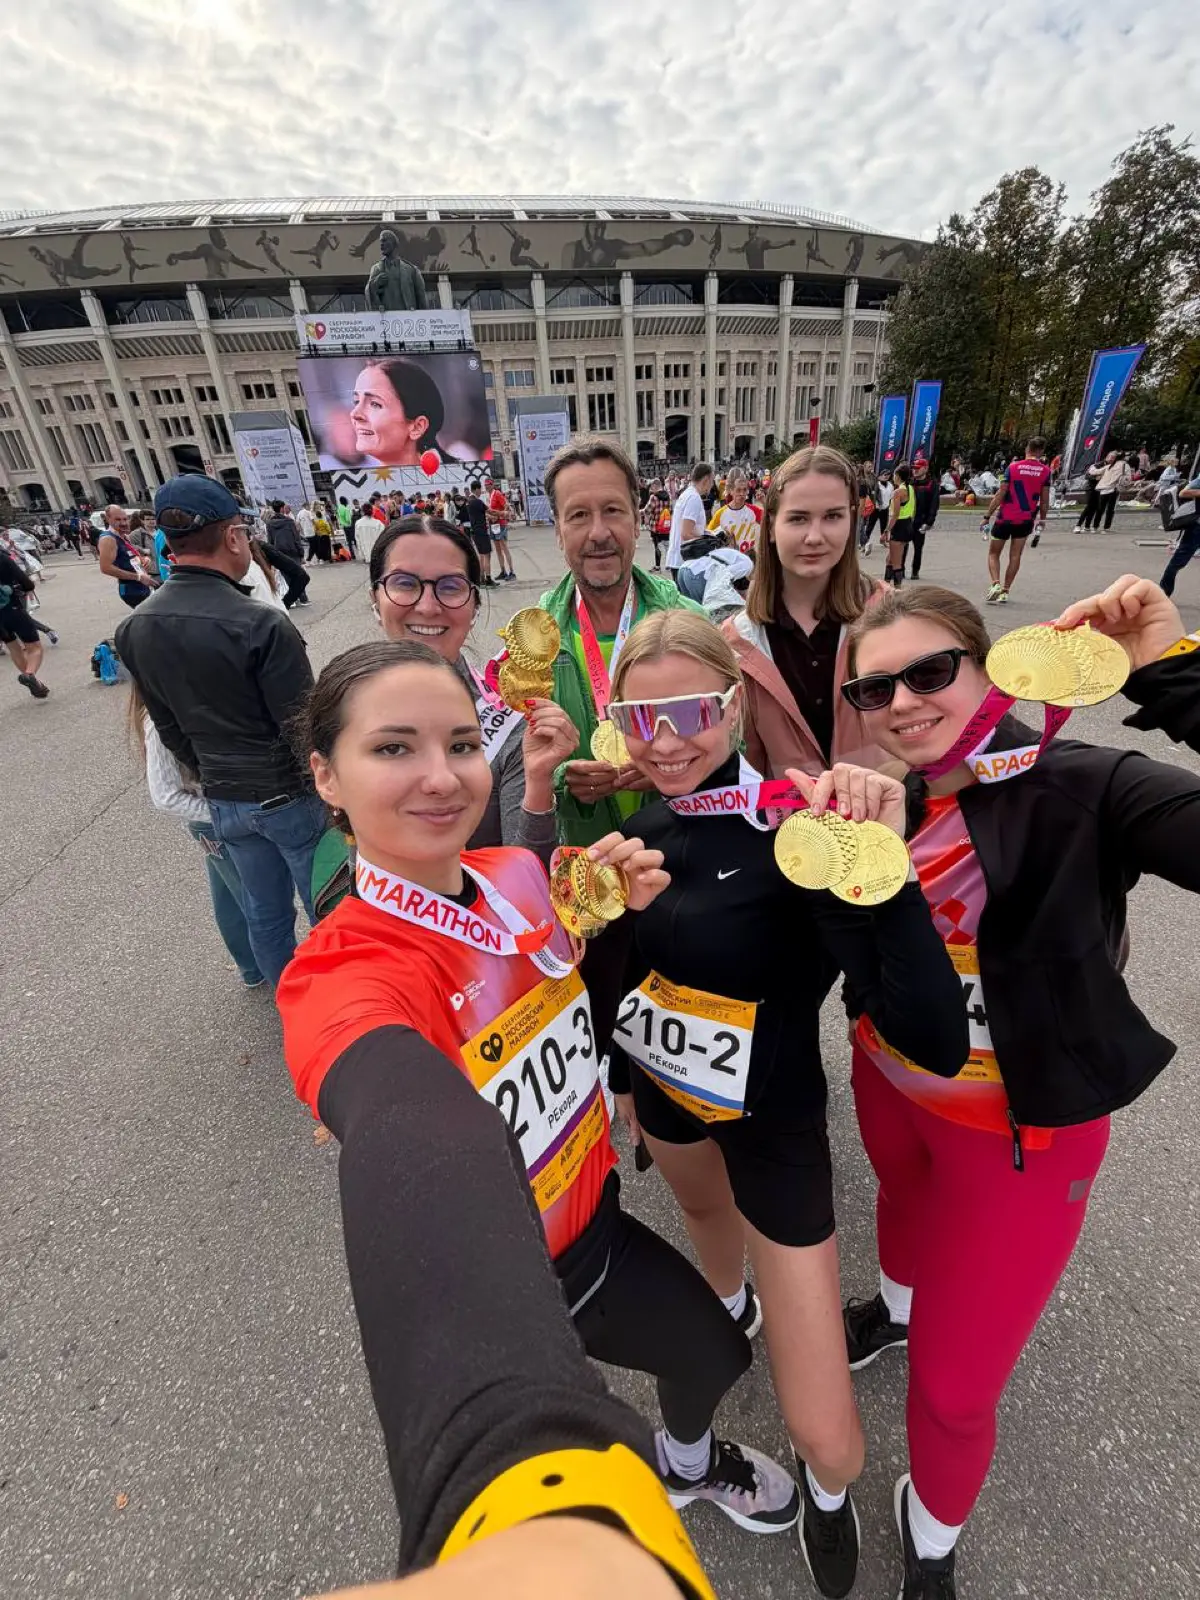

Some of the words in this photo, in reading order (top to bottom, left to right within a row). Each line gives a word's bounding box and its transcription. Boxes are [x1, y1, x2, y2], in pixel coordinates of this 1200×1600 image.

[330, 332, 366, 340] МАРАФОН
[379, 318, 427, 339] 2026
[1095, 380, 1115, 416] Видео
[1090, 416, 1104, 432] VK
[670, 788, 749, 814] ARATHON
[363, 869, 501, 951] MARATHON
[504, 1001, 545, 1039] МОСКОВСКИЙ
[508, 1018, 541, 1050] МАРАФОН
[614, 996, 741, 1077] 210-2
[495, 1006, 593, 1141] 210-3
